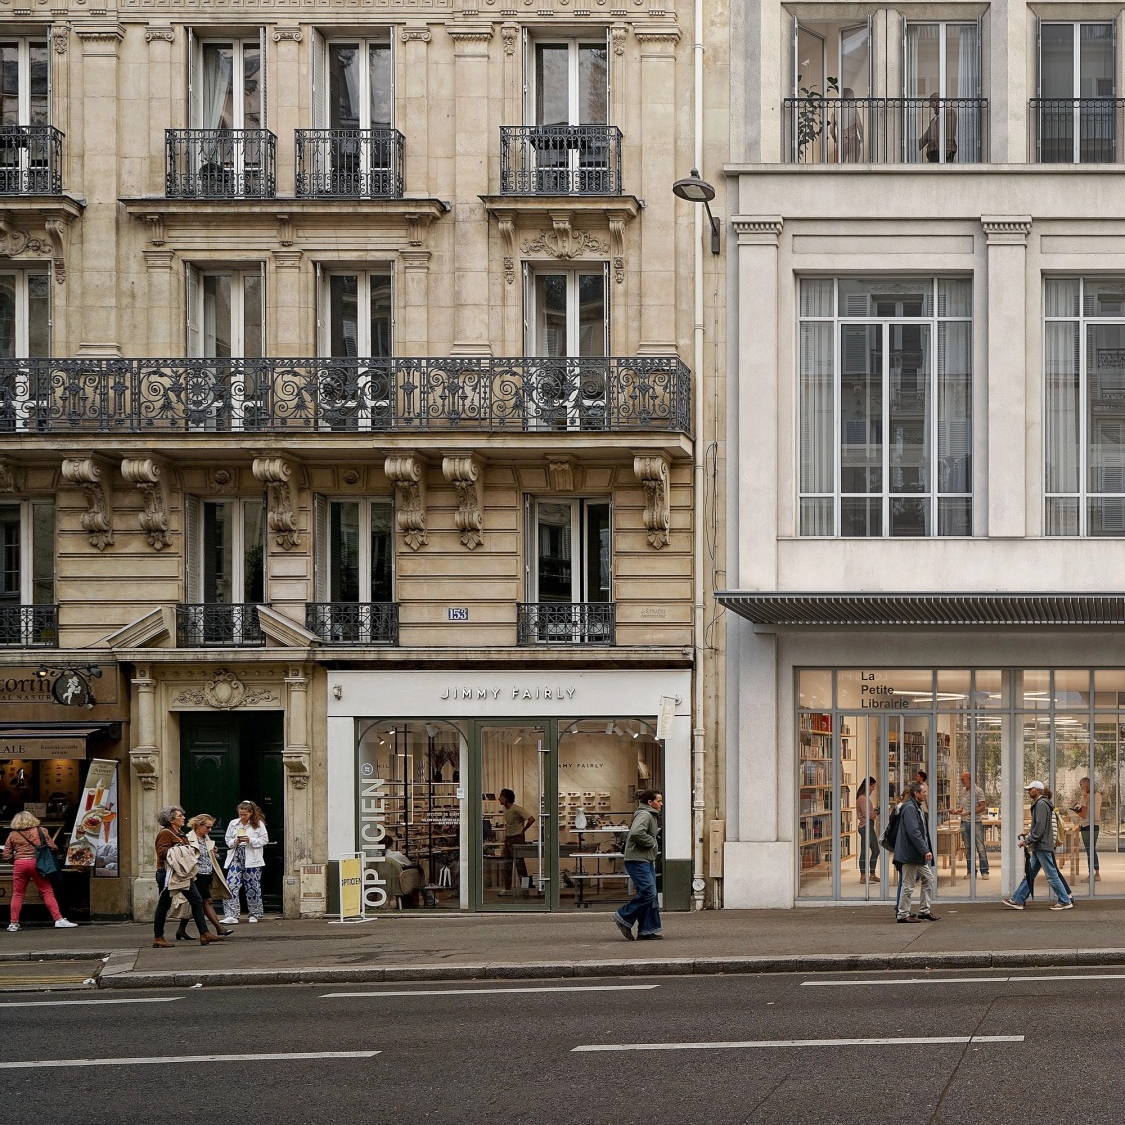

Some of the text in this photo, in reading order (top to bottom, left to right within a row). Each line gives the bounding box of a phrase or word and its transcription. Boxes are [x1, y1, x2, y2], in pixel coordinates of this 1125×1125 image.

[450, 608, 467, 620] 153
[861, 671, 875, 681] La
[440, 688, 576, 700] JIMMY FAIRLY
[861, 684, 895, 695] Petite
[861, 698, 910, 709] Librairie
[0, 744, 26, 754] ALE
[361, 778, 387, 907] OPTICIEN
